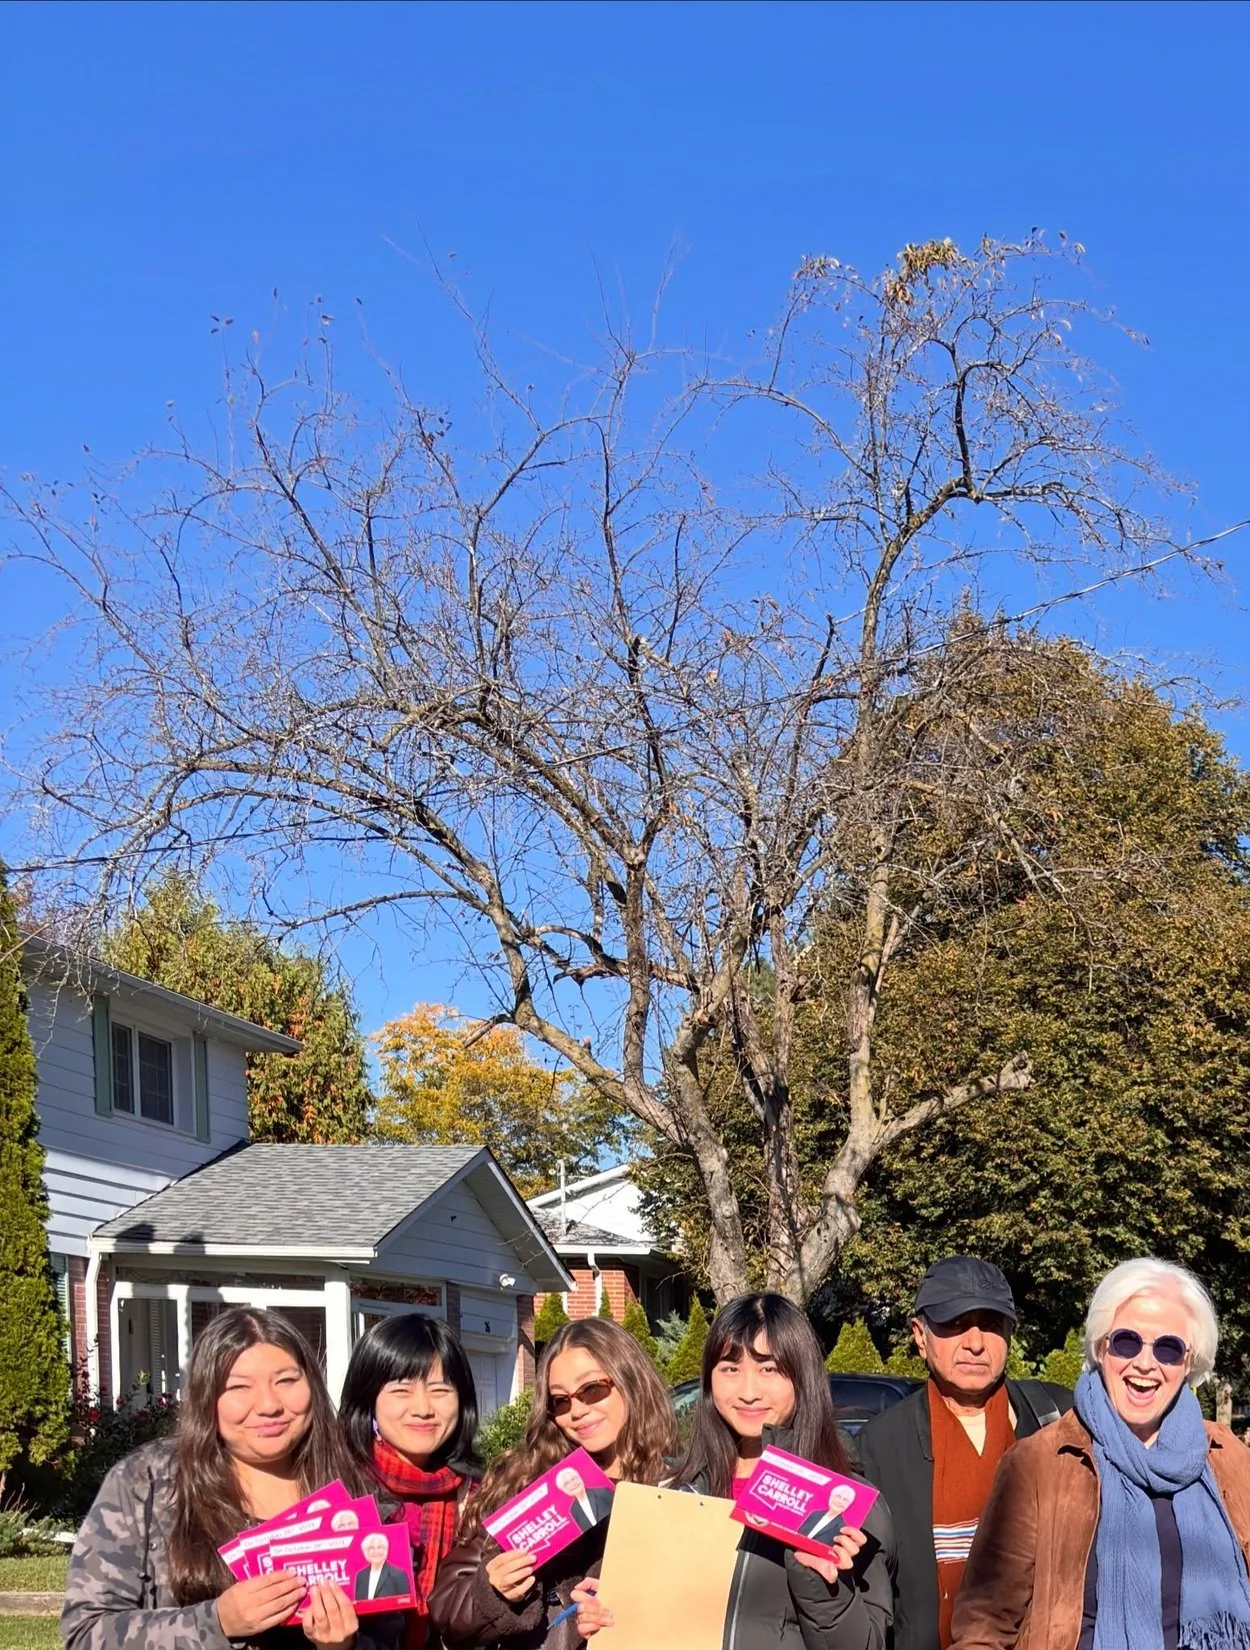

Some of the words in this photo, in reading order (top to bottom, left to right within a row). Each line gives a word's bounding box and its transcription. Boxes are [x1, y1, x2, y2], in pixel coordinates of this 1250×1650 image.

[757, 1484, 807, 1513] CARROLL
[762, 1474, 814, 1501] SHELLEY
[511, 1504, 558, 1545] SHELLEY
[519, 1514, 568, 1551] CARROLL
